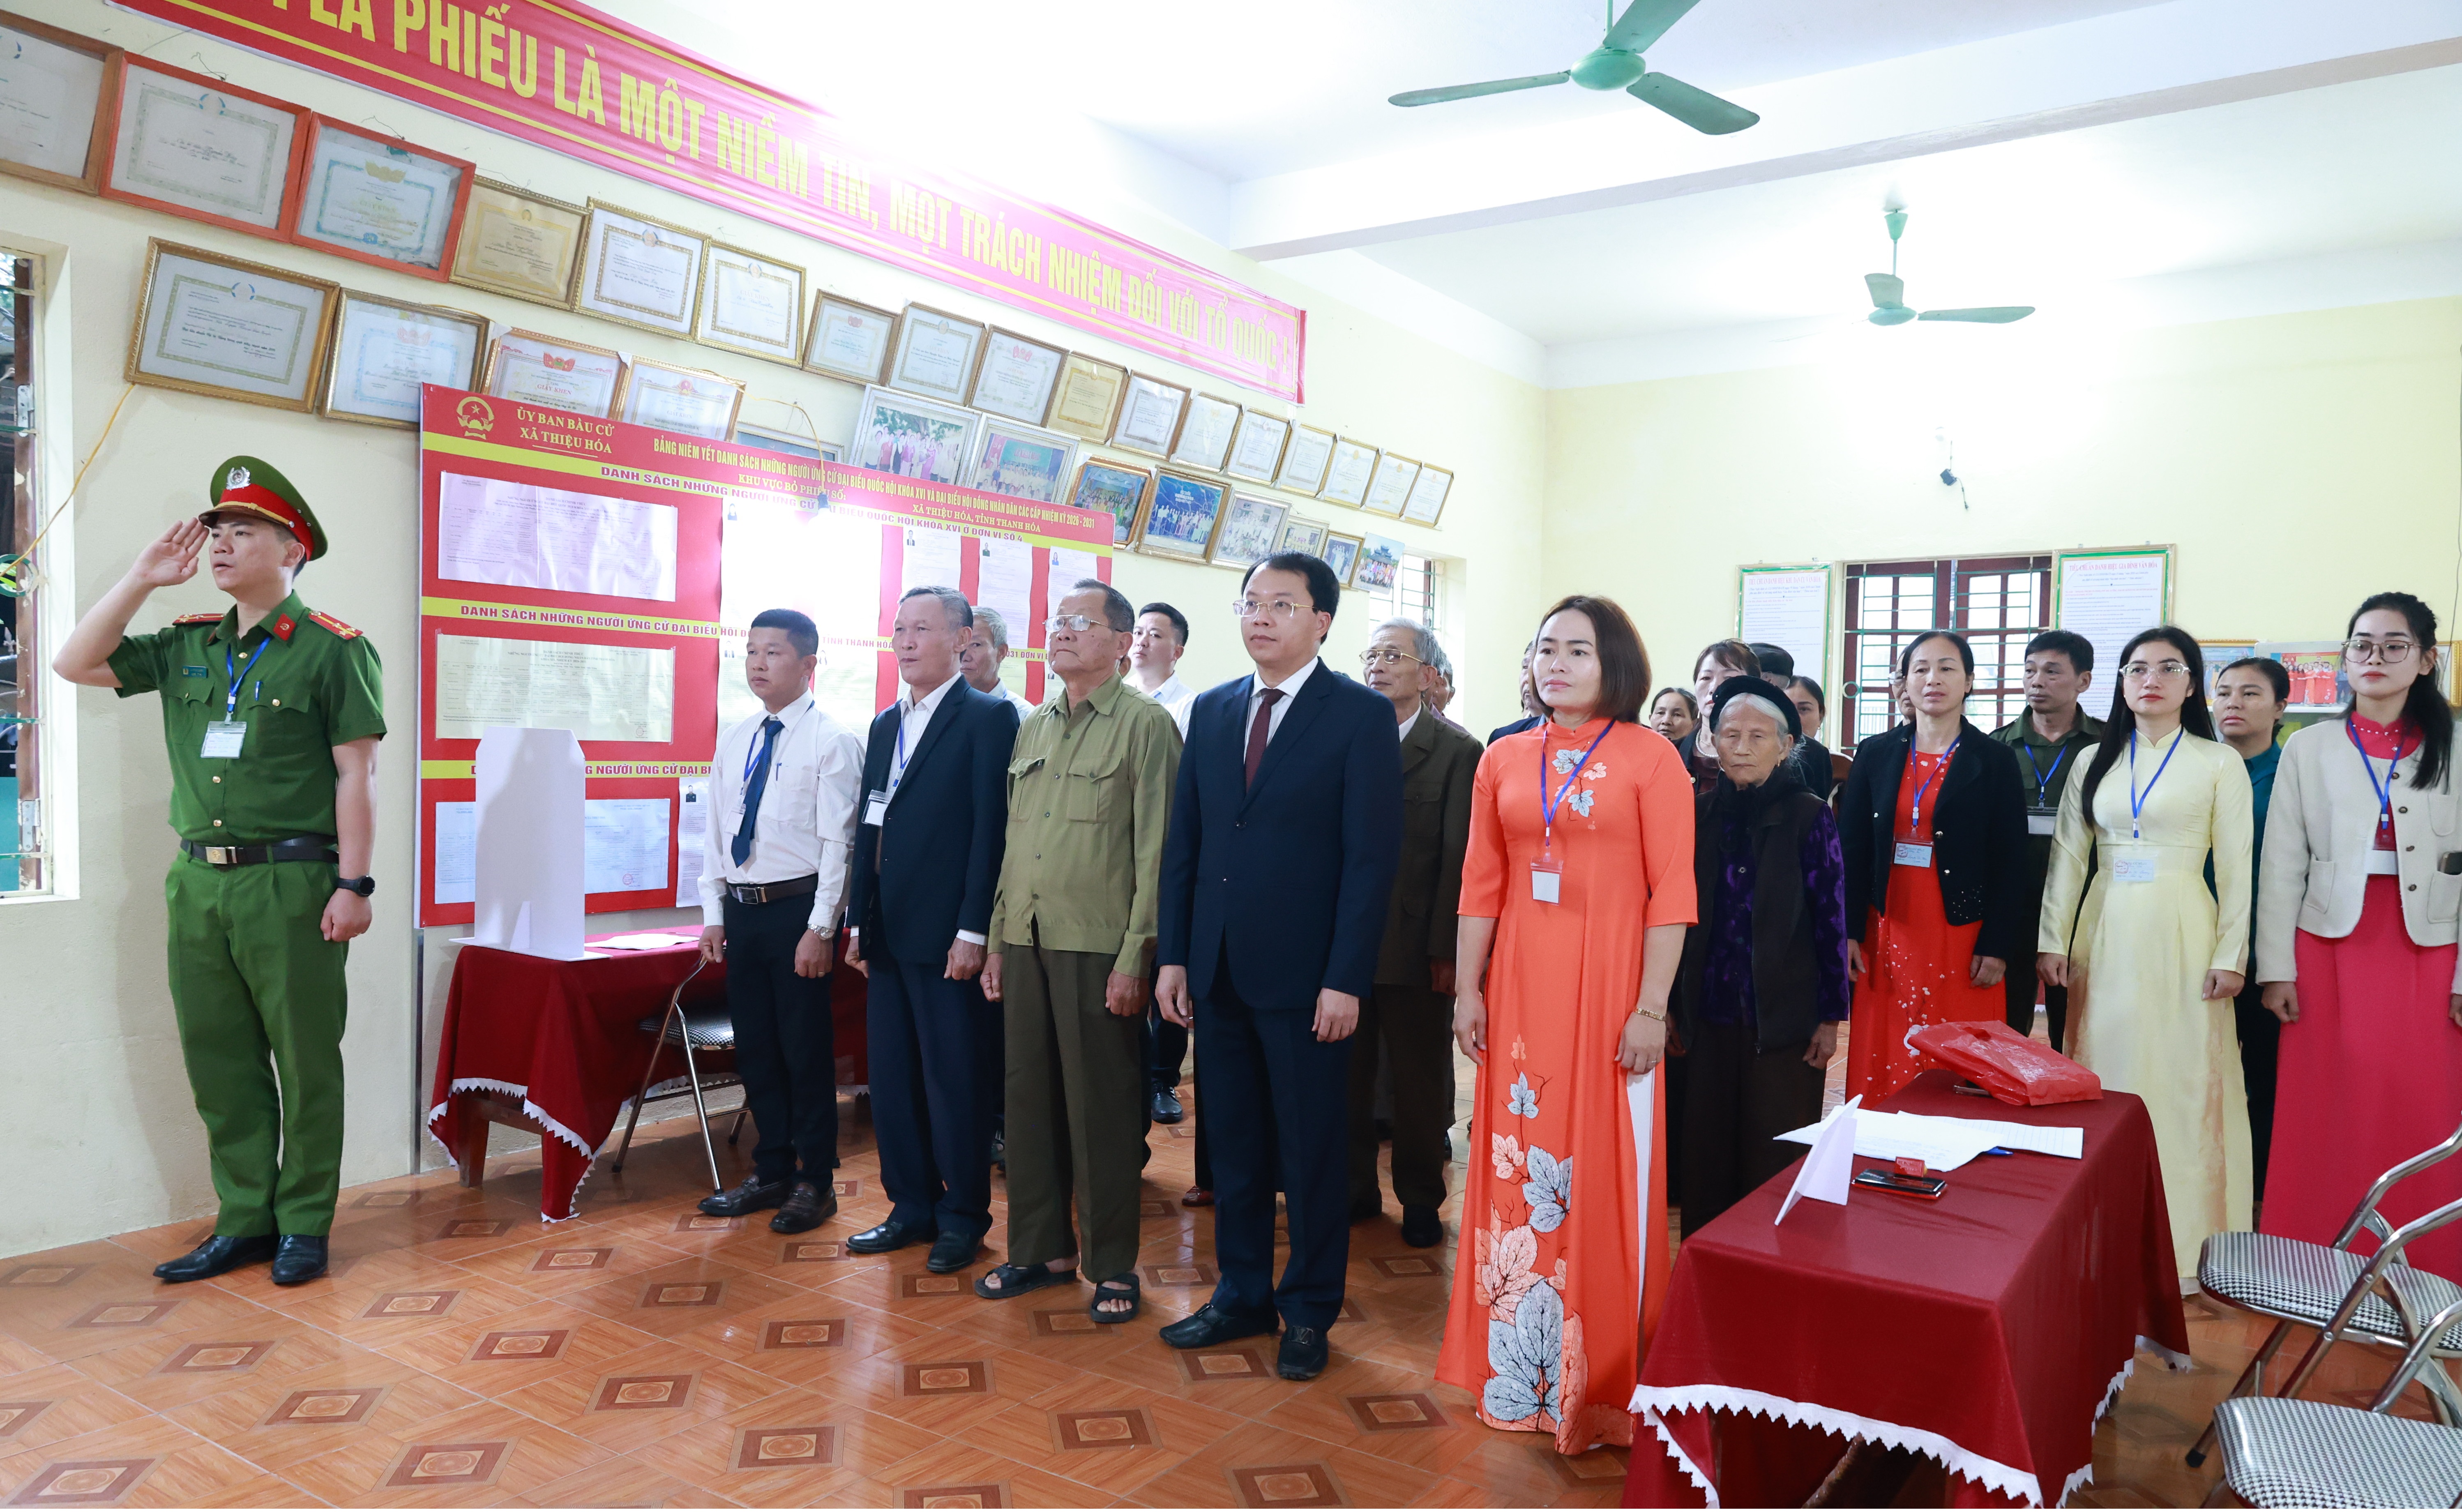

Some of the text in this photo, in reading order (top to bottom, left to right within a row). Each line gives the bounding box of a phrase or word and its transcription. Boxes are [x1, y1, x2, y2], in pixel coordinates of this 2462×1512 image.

[394, 0, 537, 98] PHIẾU
[554, 43, 606, 126] LÀ
[620, 72, 705, 165] MỘT
[717, 110, 809, 199] NIỀM
[819, 150, 879, 231] TIN,
[959, 206, 1042, 284] TRÁCH
[1048, 242, 1122, 316] NHIỆM
[1127, 268, 1163, 328] ĐỐI
[1169, 288, 1200, 341] VỚI
[1205, 295, 1229, 351] TỔ
[1232, 313, 1278, 369] QUỐC
[1282, 336, 1289, 374] !
[517, 406, 615, 437] ỦY BAN BẦU CỬ
[520, 426, 612, 454] XÃ THIỆU HÓA
[654, 436, 676, 454] BẢNG
[678, 442, 699, 459] NIÊM
[699, 445, 715, 461] YẾT
[717, 449, 738, 467] DANH
[739, 454, 760, 470] SÁCH
[761, 458, 786, 475] NHỮNG
[788, 463, 811, 480] NGƯỜI
[827, 468, 838, 483] CỬ
[837, 473, 849, 489] ĐẠI
[851, 472, 866, 489] BIỂU
[867, 476, 885, 493] QUỐC
[885, 480, 897, 497] HỘI
[898, 482, 914, 498] KHÓA
[915, 487, 926, 500] XVI
[927, 487, 936, 502] VÀ
[936, 490, 946, 507] ĐẠI
[947, 490, 961, 507] BIỂU
[962, 494, 972, 511] HỘI
[973, 494, 989, 511] ĐỒNG
[990, 499, 1005, 514] NHÂN
[1006, 502, 1018, 516] DÂN
[1019, 504, 1029, 518] CÁC
[1030, 505, 1041, 519] CẤP
[1042, 509, 1059, 525] NHIỆM
[1059, 512, 1067, 524] KỲ
[1067, 514, 1079, 526] 2026
[1083, 517, 1095, 529] 2031
[738, 474, 760, 486] KHU
[763, 478, 783, 491] VỰC
[784, 480, 798, 493] BỎ
[831, 486, 847, 501] SỐ:
[601, 466, 640, 481] DANH
[643, 472, 680, 488] SÁCH
[683, 479, 728, 496] NHỮNG
[799, 498, 816, 509] CỬ
[867, 511, 895, 523] QUỐC
[917, 518, 943, 530] KHÓA
[945, 523, 961, 533] XVI
[963, 522, 969, 534] Ở
[971, 527, 991, 537] ĐƠN
[1004, 530, 1015, 541] SỐ
[912, 503, 1041, 532] XÃ THIỆU HÓA, TỈNH THANH HÓA
[461, 606, 498, 617] DANH
[502, 608, 536, 621] SÁCH
[540, 612, 583, 624] NHỮNG
[588, 615, 624, 628] NGƯỜI
[627, 618, 651, 630] ỨNG
[654, 620, 669, 632] CỬ
[672, 624, 689, 634] ĐẠI
[693, 623, 717, 635] BIỂU
[846, 638, 874, 647] THANH
[596, 764, 632, 775] NGƯỜI
[636, 763, 659, 775] ỨNG
[662, 763, 678, 774] CỬ
[680, 765, 698, 777] ĐẠI
[701, 765, 711, 774] BI
